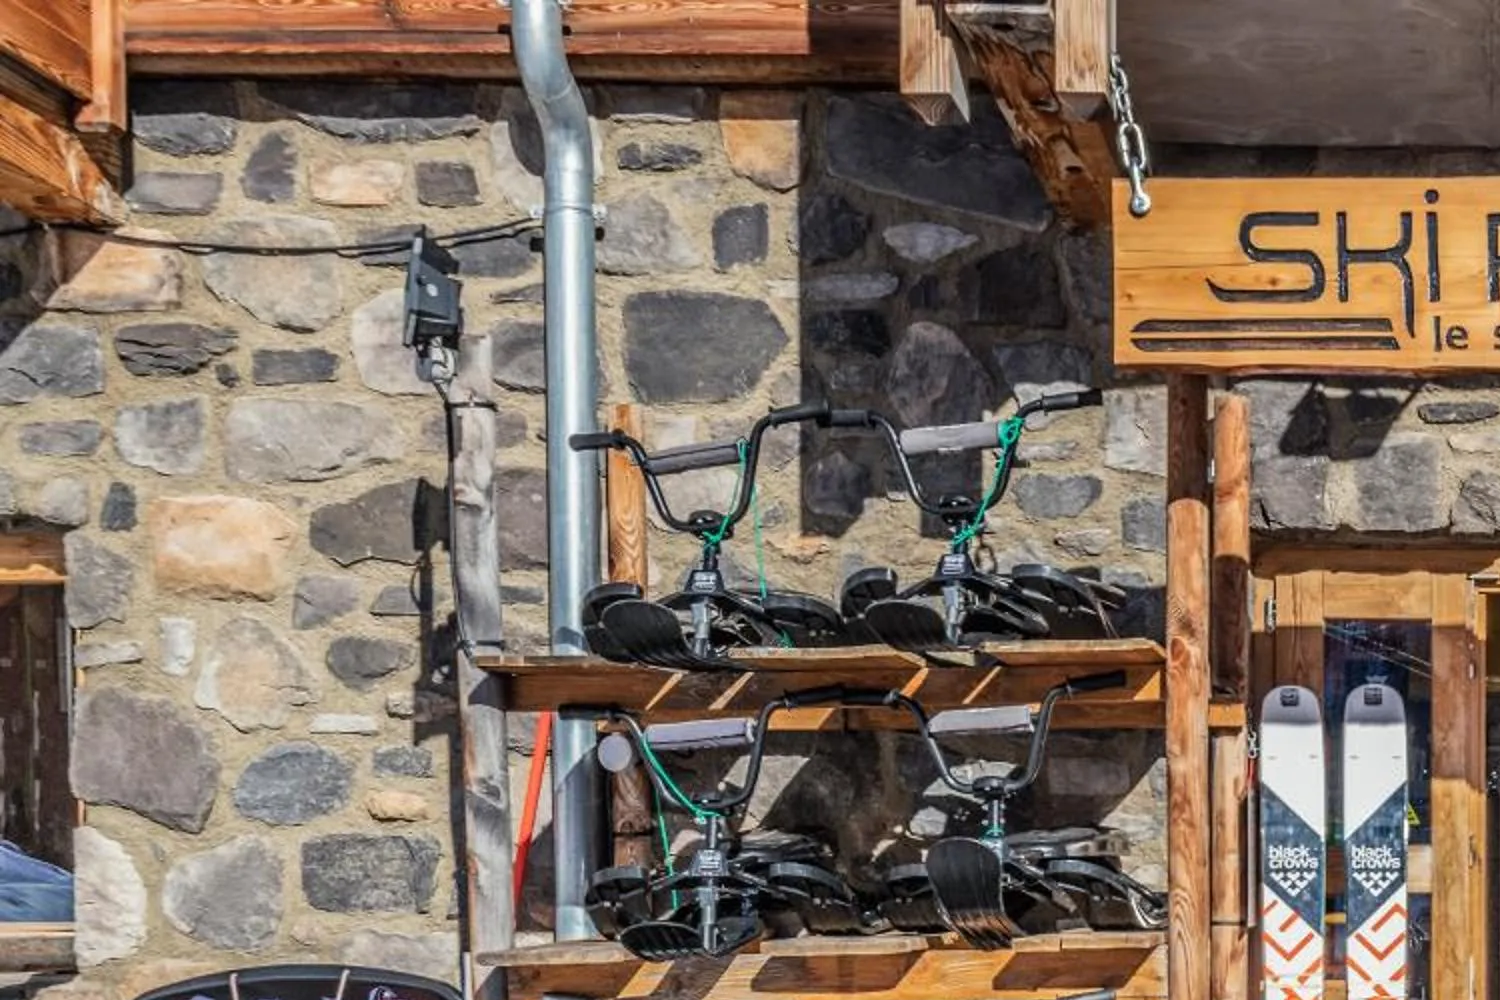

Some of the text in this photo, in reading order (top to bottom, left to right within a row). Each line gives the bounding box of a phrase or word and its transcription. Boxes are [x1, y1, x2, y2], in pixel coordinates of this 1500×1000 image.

[1433, 315, 1469, 352] le
[1269, 844, 1310, 858] black
[1351, 844, 1393, 858] black
[1269, 857, 1319, 869] crows
[1351, 857, 1401, 869] crows
